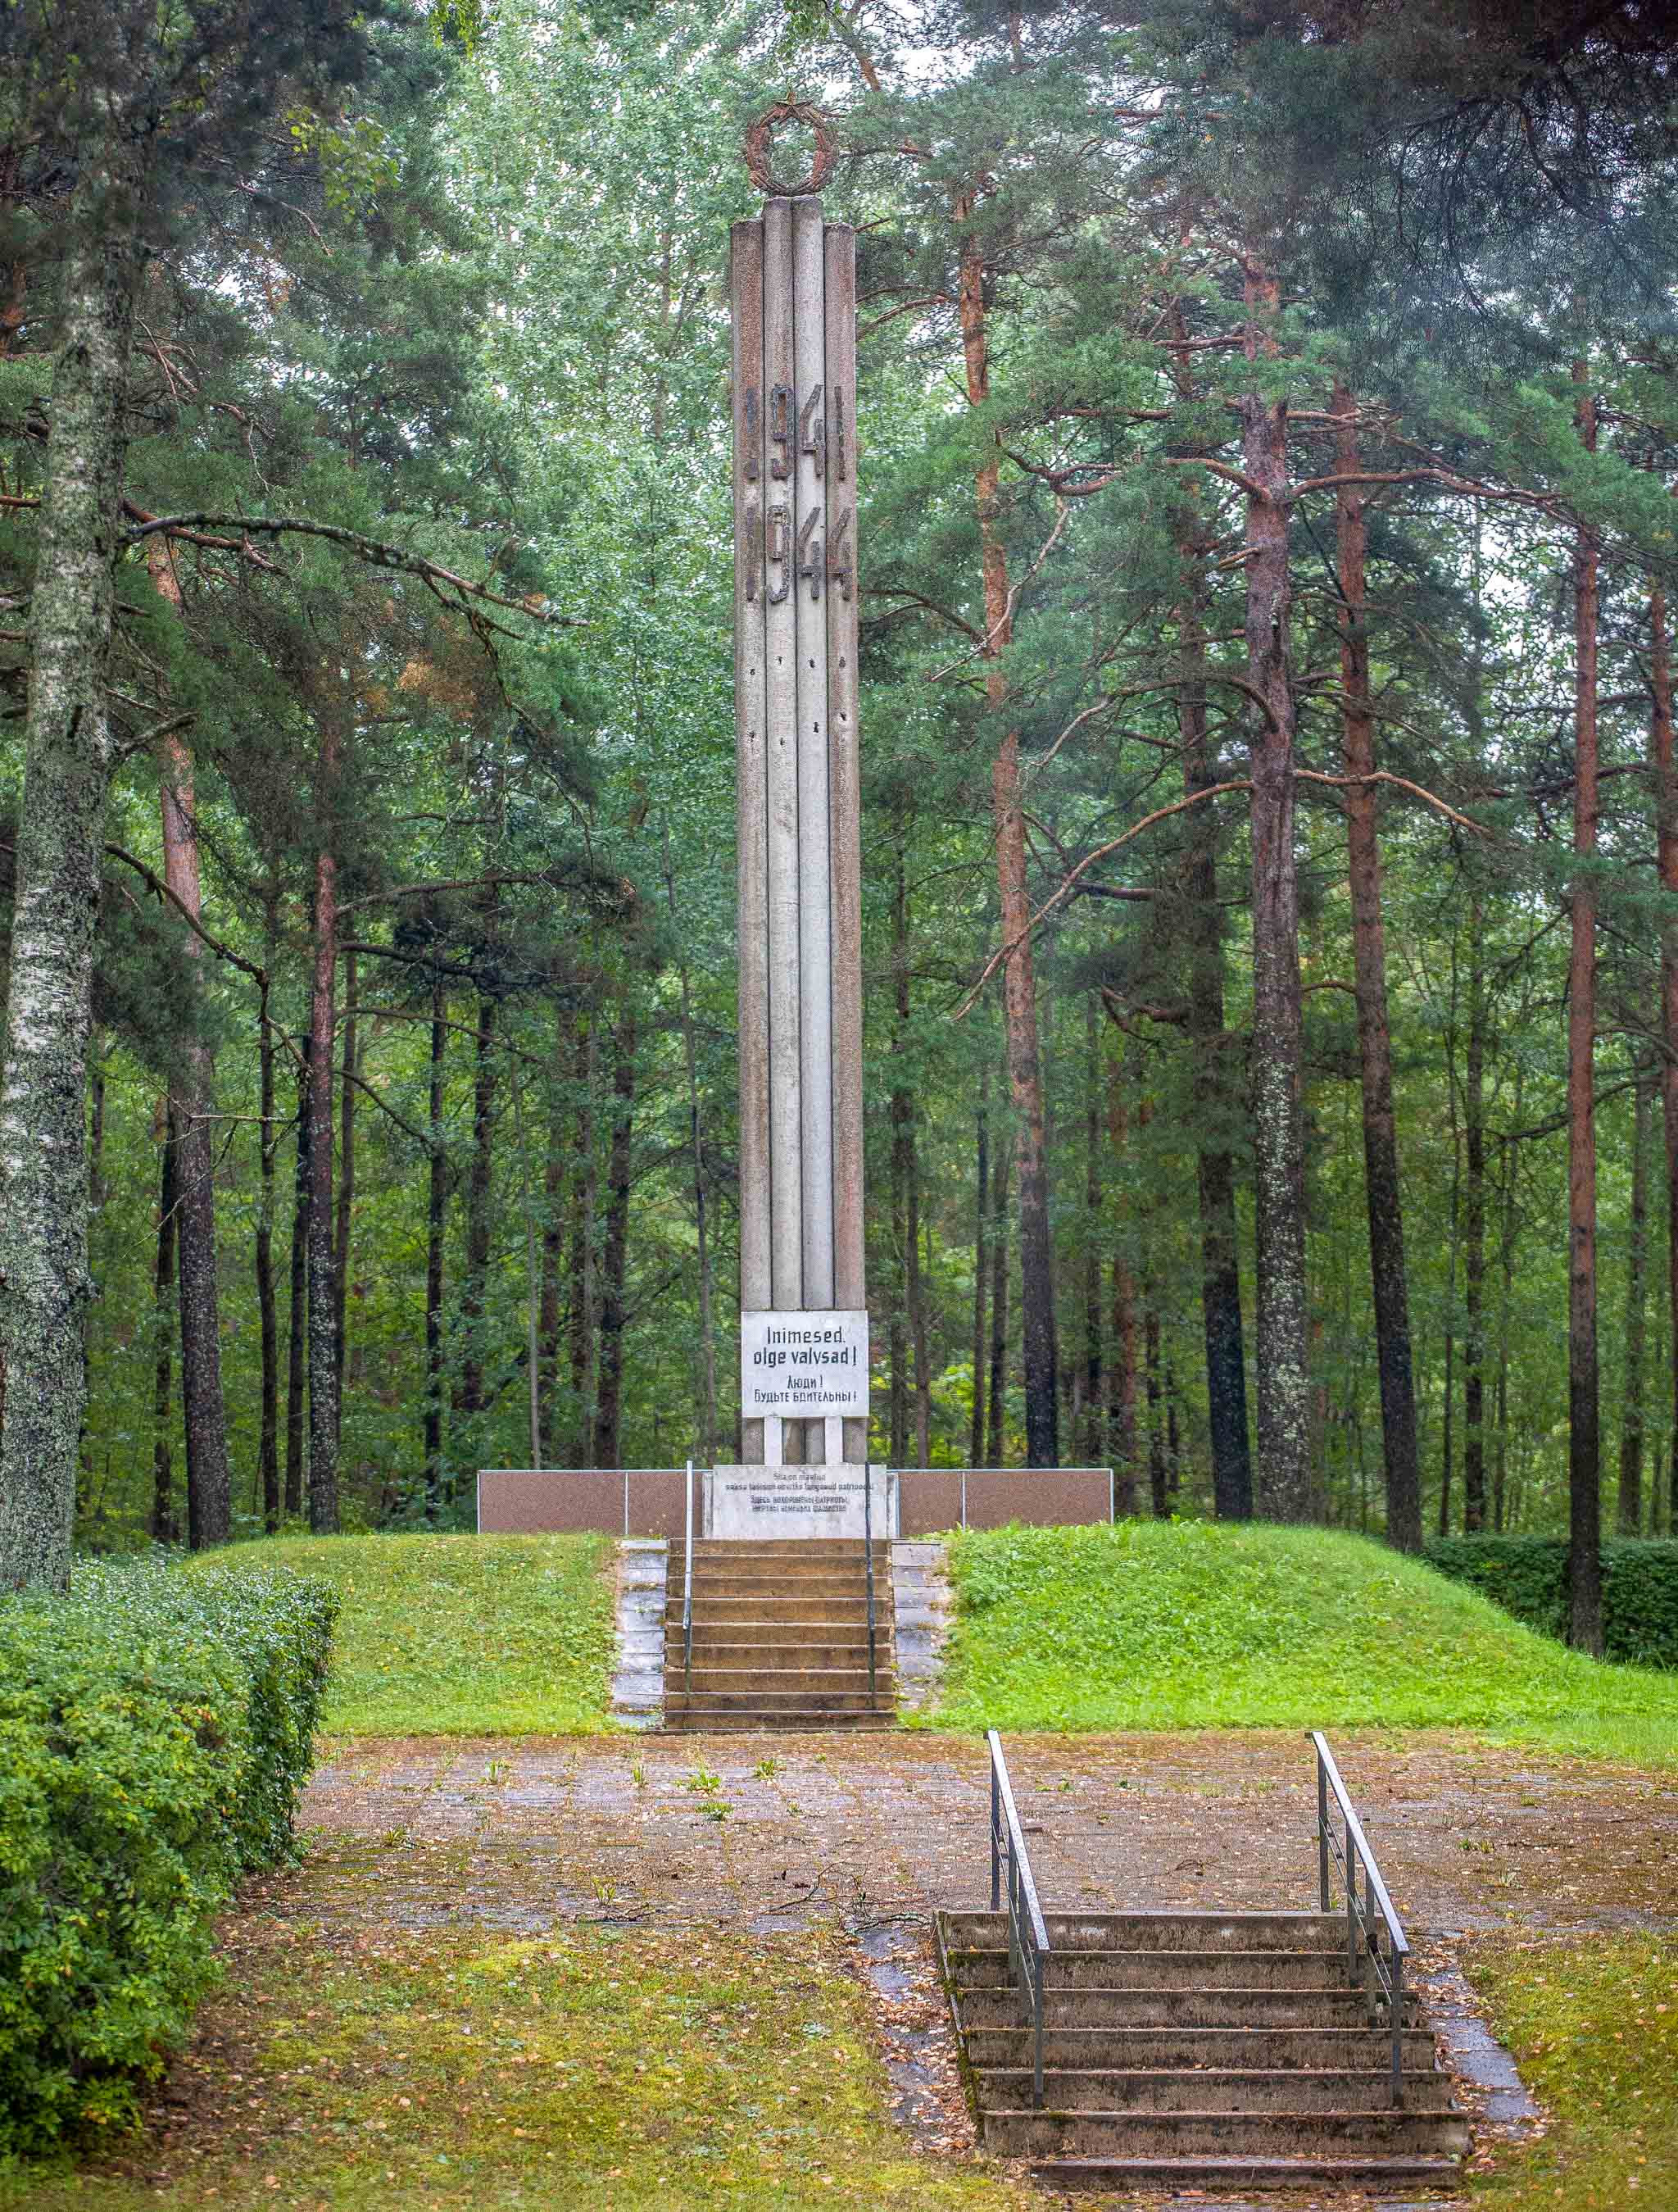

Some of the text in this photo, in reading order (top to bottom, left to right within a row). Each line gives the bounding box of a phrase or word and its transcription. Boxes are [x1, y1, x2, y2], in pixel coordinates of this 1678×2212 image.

[746, 384, 846, 479] 1941
[746, 505, 853, 602] 1944
[753, 1347, 786, 1368] olge
